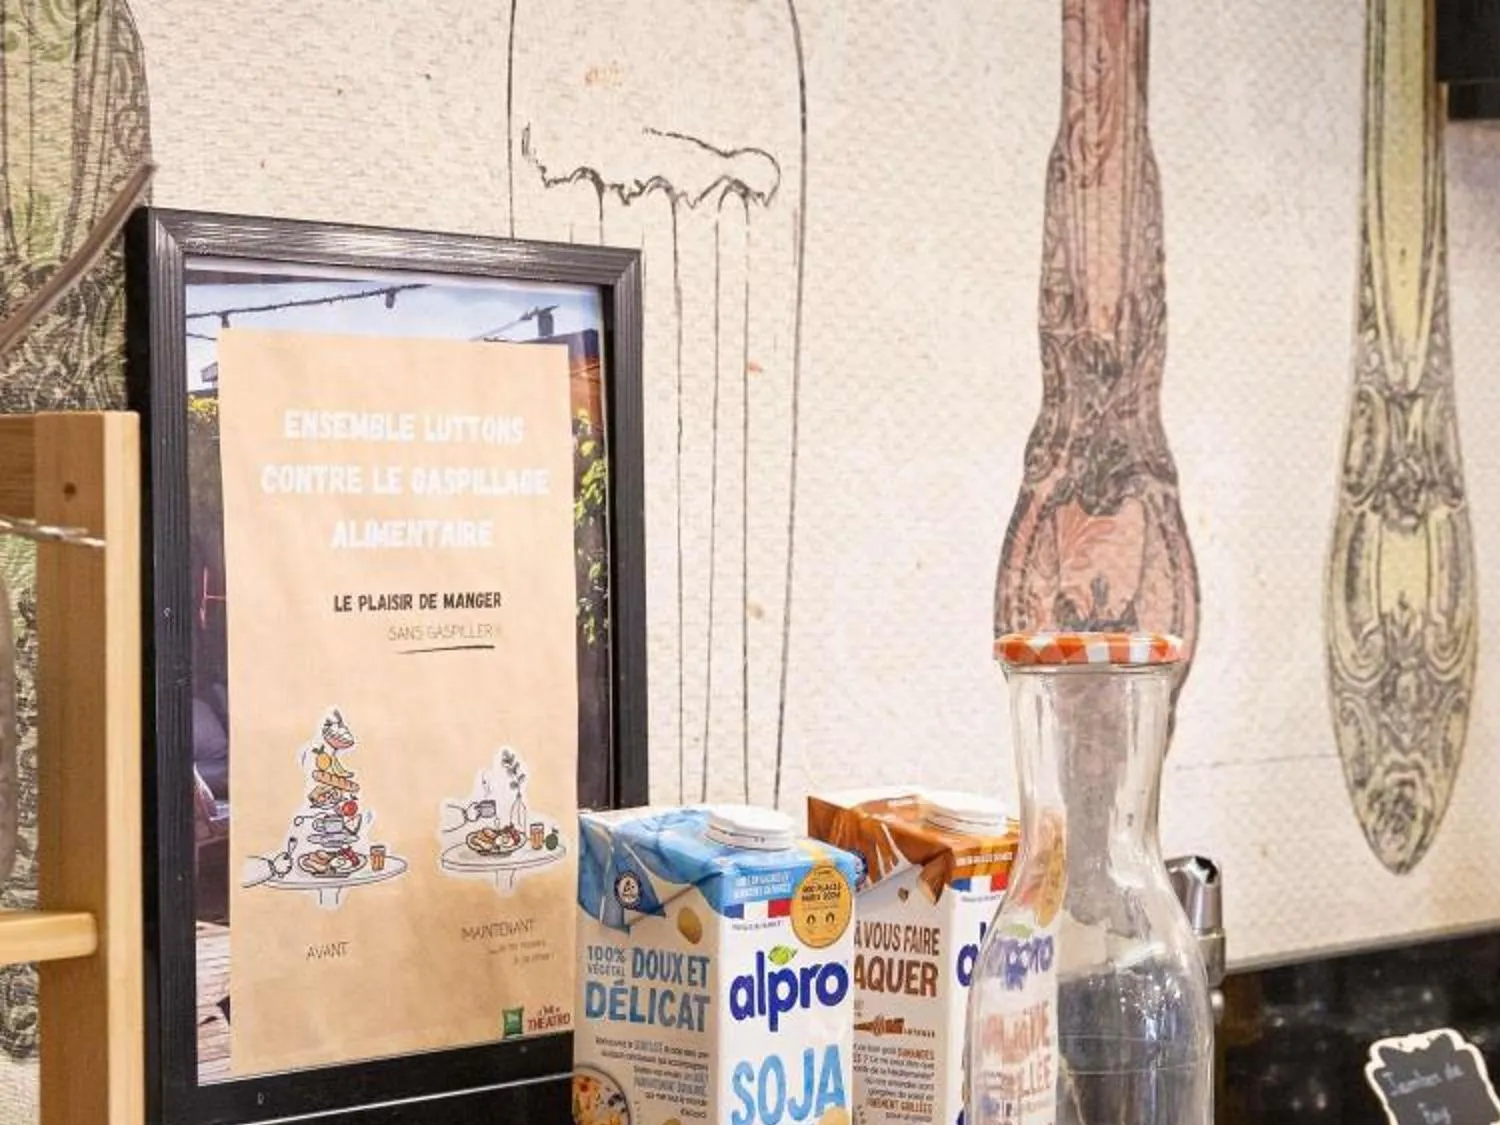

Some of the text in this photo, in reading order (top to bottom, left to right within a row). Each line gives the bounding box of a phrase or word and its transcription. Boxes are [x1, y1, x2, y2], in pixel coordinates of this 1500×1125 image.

[283, 410, 526, 444] ENSEMBLE LUTTONS
[260, 464, 551, 496] CONTRE LE GASPILLAGE
[331, 518, 495, 549] ALIMENTAIRE
[333, 591, 502, 612] LE PLAISIR DE MANGER
[388, 625, 423, 641] SANS
[427, 623, 492, 640] GASPILLER
[461, 918, 536, 941] MAINTENANT
[863, 921, 901, 951] VOUS
[903, 925, 941, 957] FAIRE
[305, 941, 349, 961] AVANT
[586, 945, 626, 963] 100%
[631, 946, 683, 985] DOUX
[687, 954, 711, 988] ET
[729, 950, 849, 1032] alpro
[853, 954, 939, 997] AQUER
[584, 979, 711, 1033] DÉLICAT
